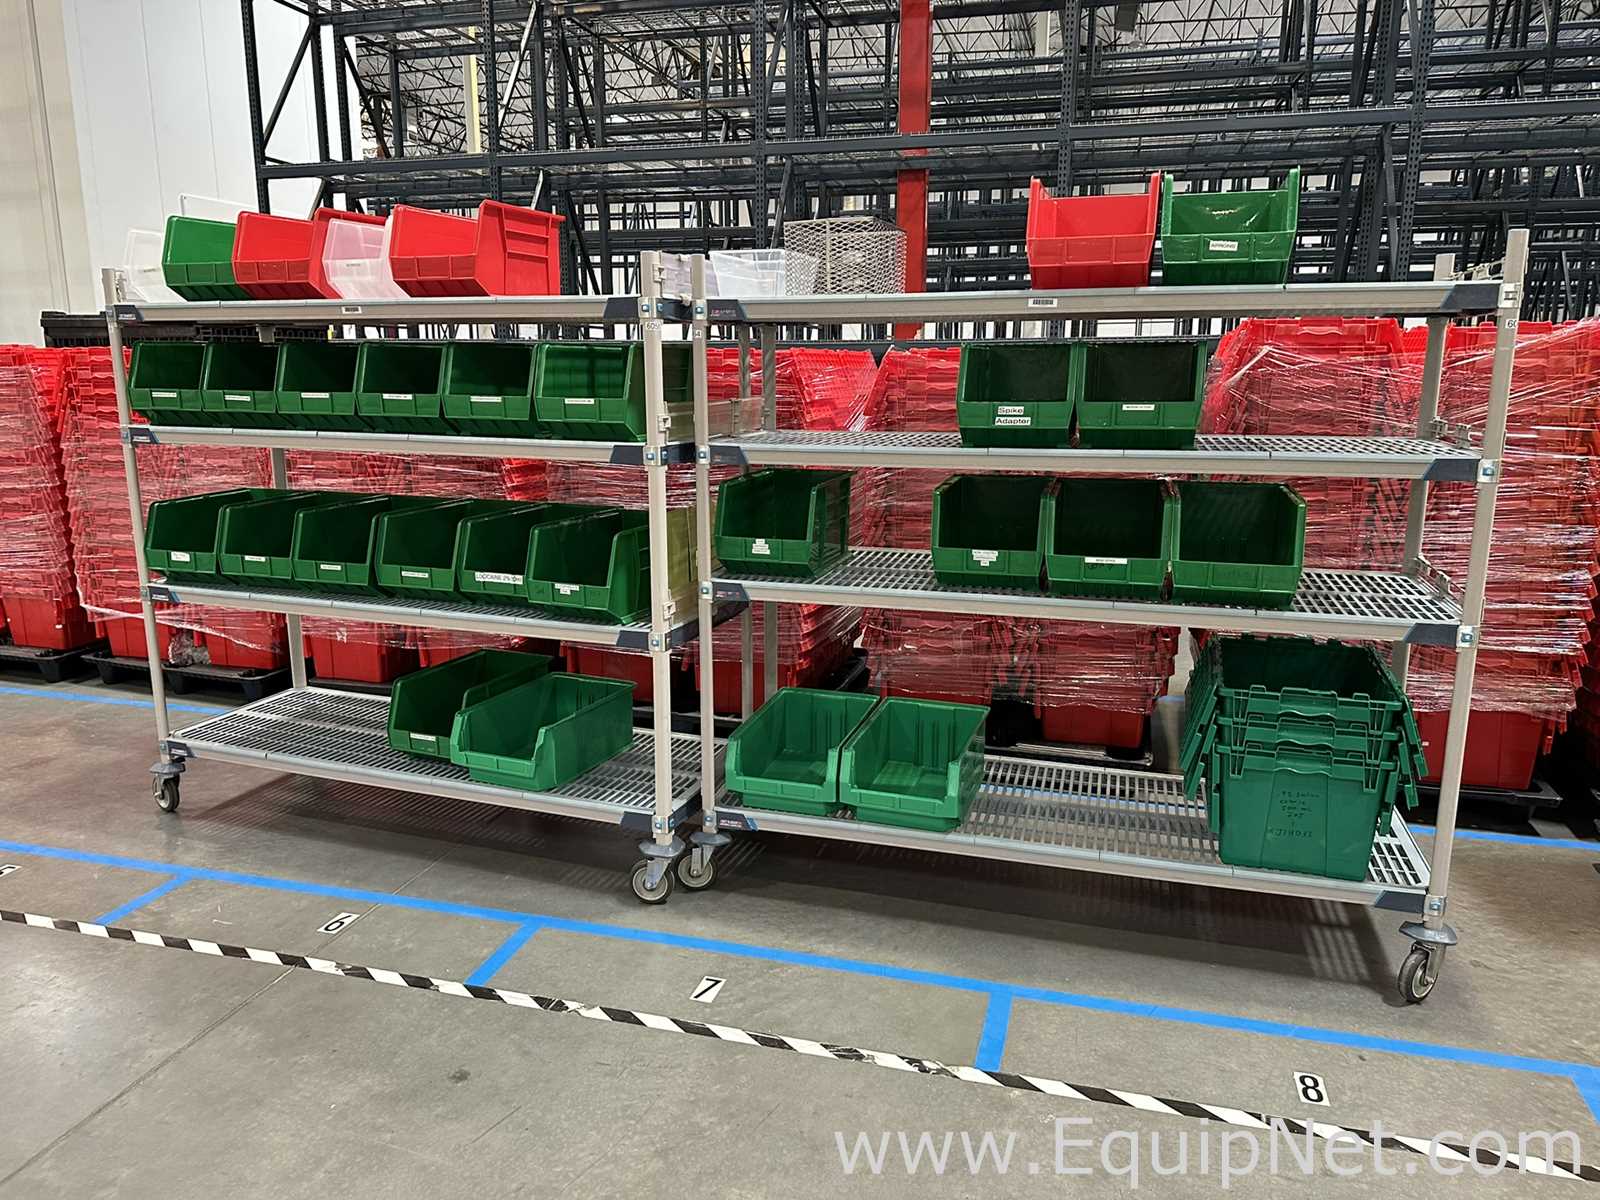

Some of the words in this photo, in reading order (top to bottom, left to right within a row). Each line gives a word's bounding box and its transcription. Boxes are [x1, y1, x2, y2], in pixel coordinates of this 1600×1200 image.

[996, 417, 1030, 425] Adapter
[324, 914, 351, 931] 6
[693, 977, 722, 999] 7
[1299, 1075, 1324, 1103] 8
